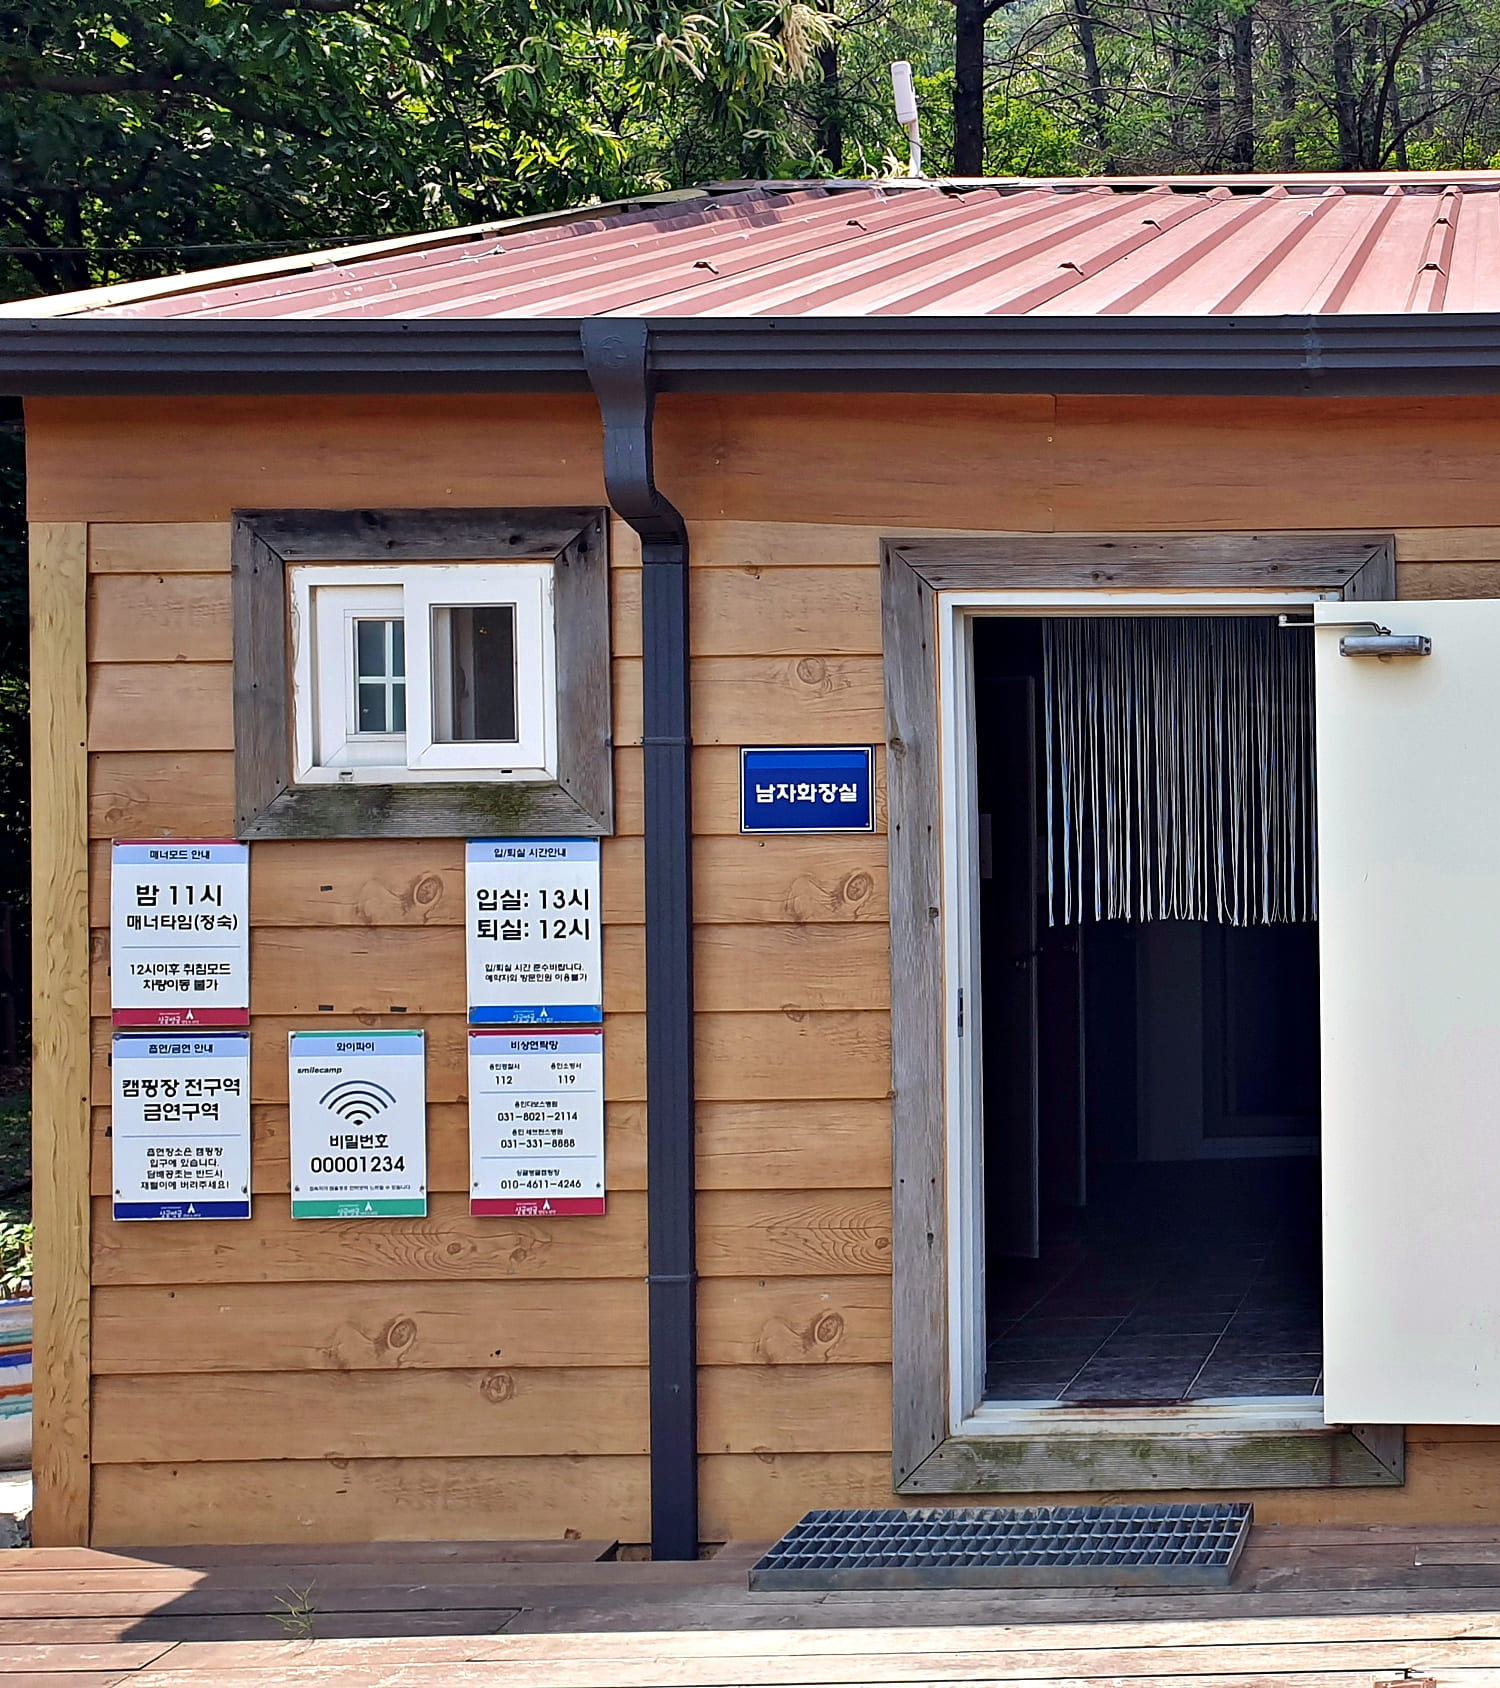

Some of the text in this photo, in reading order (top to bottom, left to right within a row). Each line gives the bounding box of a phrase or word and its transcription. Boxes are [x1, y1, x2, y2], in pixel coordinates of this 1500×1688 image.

[755, 782, 857, 804] 남자화장실
[149, 849, 210, 860] 매너모드 안내
[493, 847, 567, 858] 입/퇴실 시간안내
[136, 884, 222, 907] 밤 11시
[476, 888, 589, 911] 입실: 13시
[126, 913, 238, 931] 매너타임(정숙)
[477, 918, 590, 941] 퇴실: 12시
[130, 963, 231, 976] 12시이후 취침모드
[484, 963, 512, 973] 입/퇴실
[514, 963, 531, 973] 시간
[143, 978, 218, 992] 차량이동 불가
[148, 1043, 214, 1054] 흡연/금연 안내
[336, 1042, 375, 1052] 와이파이
[510, 1040, 559, 1051] 비상연락망
[297, 1066, 343, 1074] smilecamp
[495, 1075, 513, 1085] 112
[558, 1074, 576, 1084] 119
[122, 1078, 241, 1098] 캠핑장 전구역
[143, 1102, 219, 1122] 금연구역
[497, 1111, 578, 1122] 031-8021-2114
[329, 1133, 389, 1150] 비밀번호
[500, 1138, 576, 1149] 031-331-8888
[195, 1147, 224, 1157] 캠핑장
[149, 1158, 177, 1169] 입구에
[310, 1155, 406, 1174] 00001234
[195, 1169, 223, 1179] 반드시
[500, 1179, 582, 1190] 010-4611-4246
